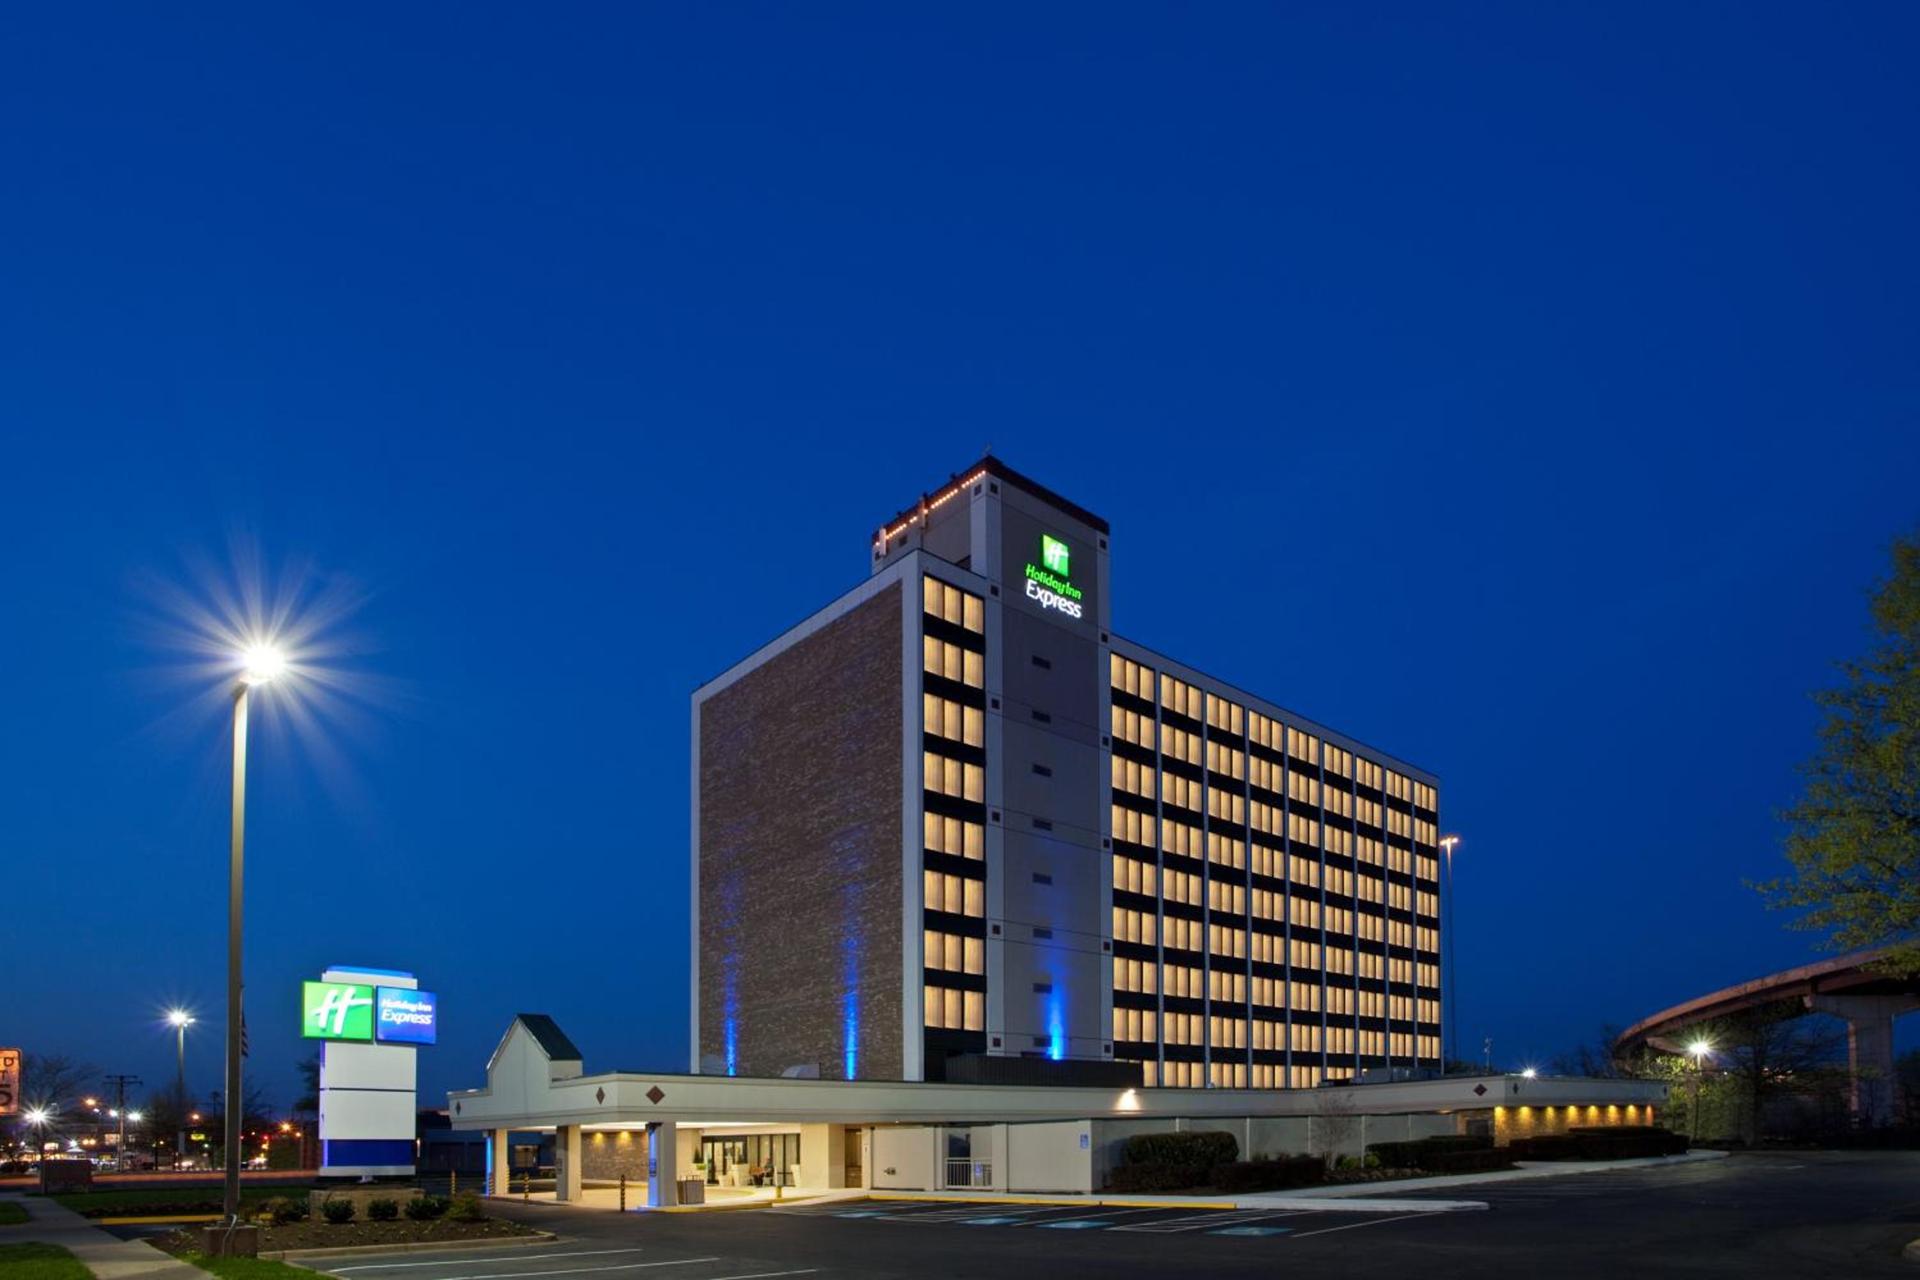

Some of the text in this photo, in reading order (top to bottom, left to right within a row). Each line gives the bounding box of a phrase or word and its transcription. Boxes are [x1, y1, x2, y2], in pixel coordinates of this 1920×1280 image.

[1025, 563, 1082, 600] Holiday Inn
[1026, 579, 1082, 618] Express
[382, 1009, 432, 1024] Express
